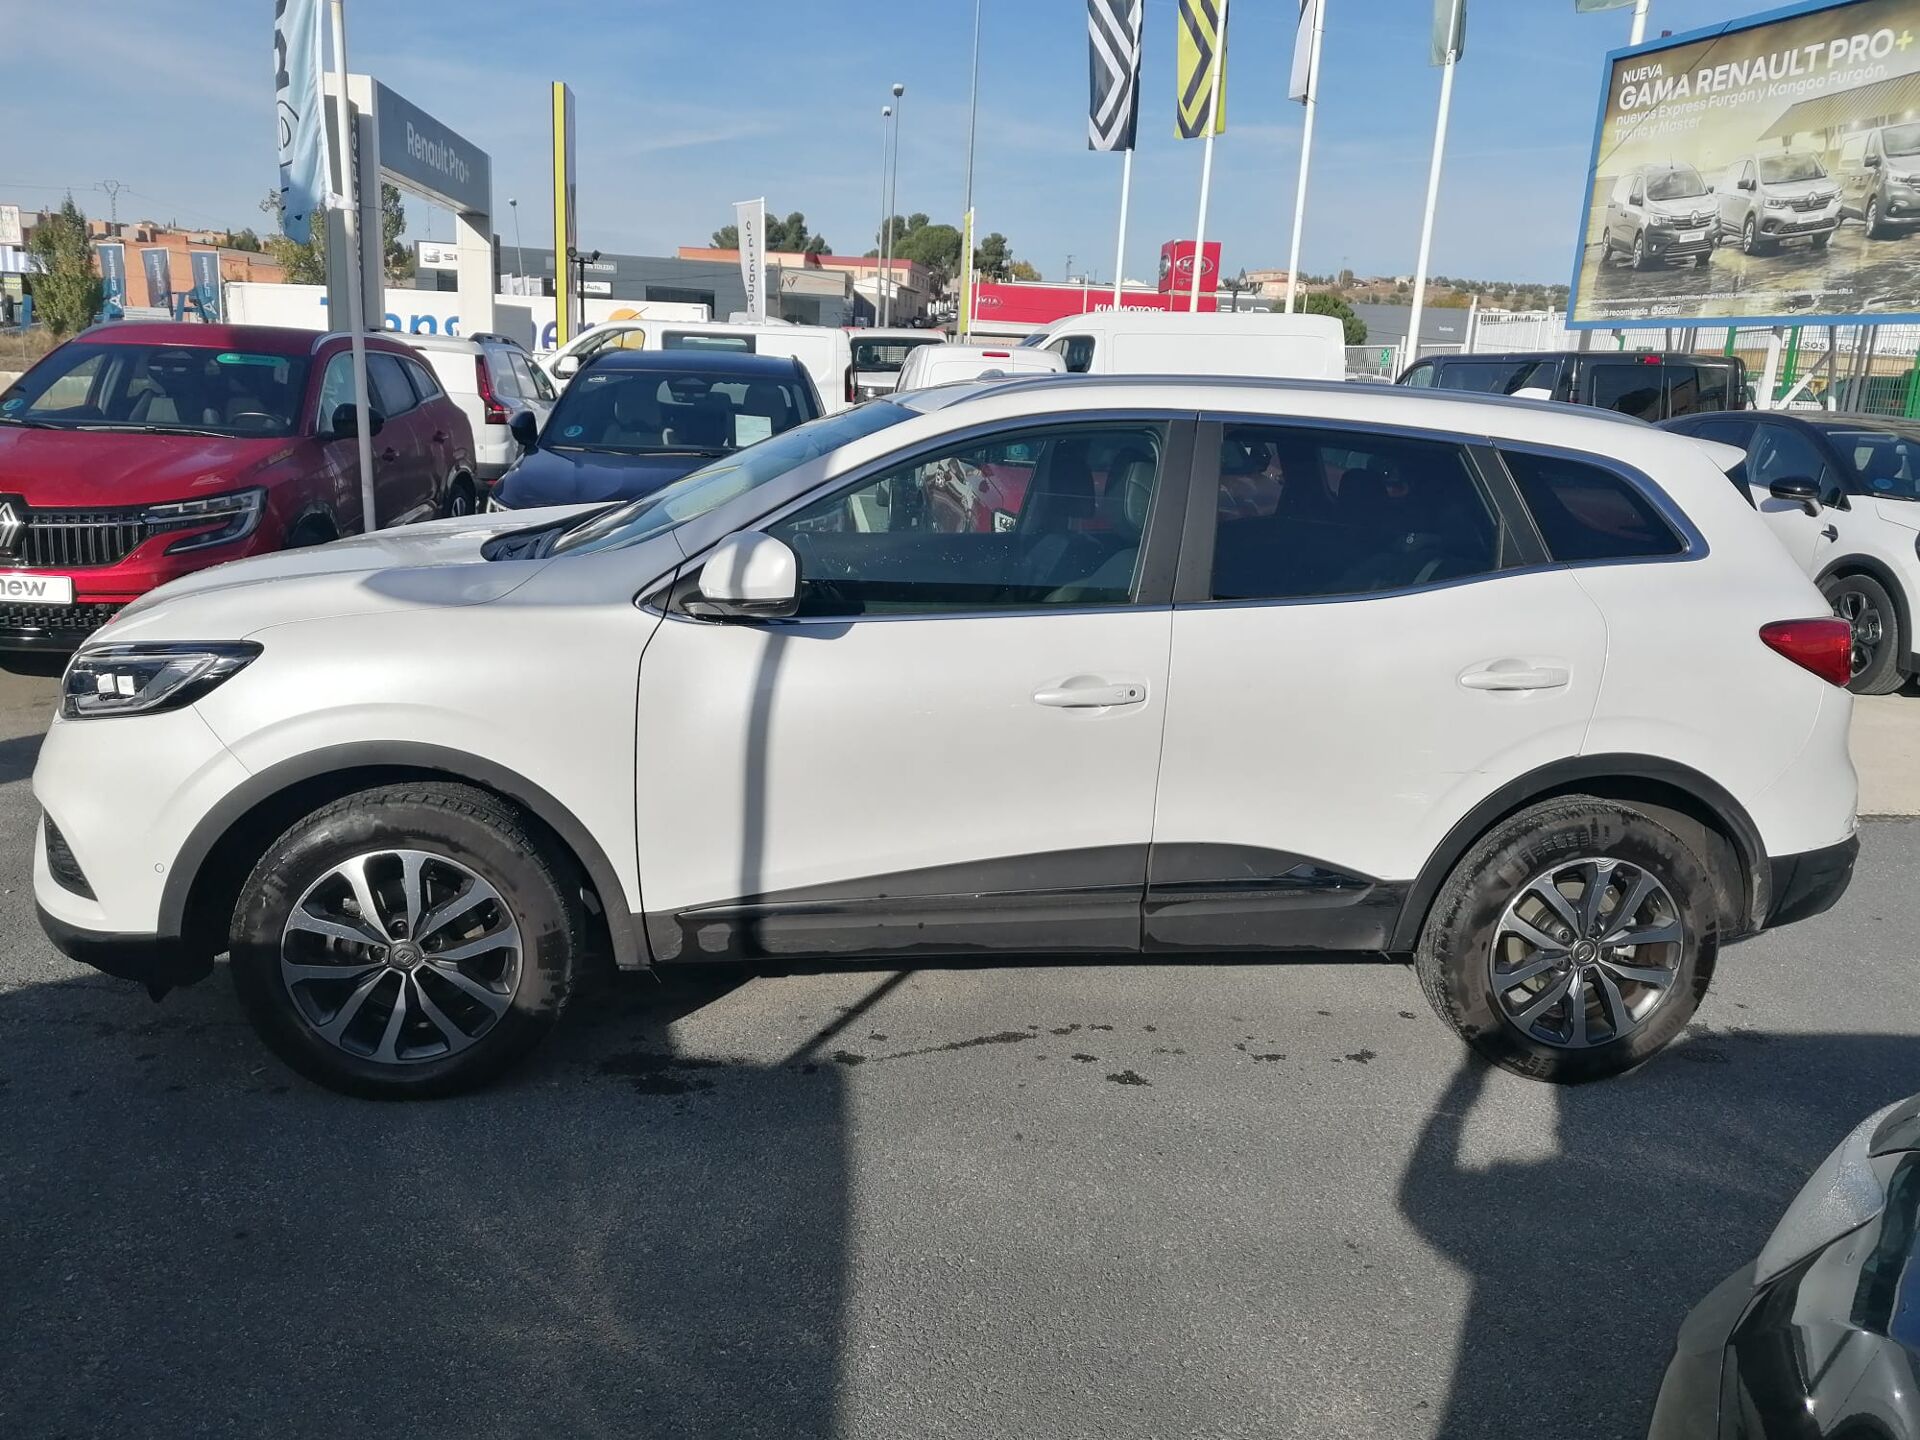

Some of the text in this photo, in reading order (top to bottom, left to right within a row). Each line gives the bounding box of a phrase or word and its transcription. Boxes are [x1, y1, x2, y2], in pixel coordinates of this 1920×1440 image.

[1619, 28, 1913, 111] GAMA RENAULT PRO+
[1621, 63, 1663, 84] NUEVA
[1615, 108, 1657, 127] nuevos
[1659, 98, 1707, 118] Express
[1707, 89, 1755, 108] Furgón
[1754, 88, 1767, 103] y
[1767, 76, 1825, 98] Kangoo
[1658, 115, 1703, 134] Master
[406, 120, 449, 174] Renault
[1094, 303, 1114, 312] KIA
[1609, 306, 1649, 317] recomienda
